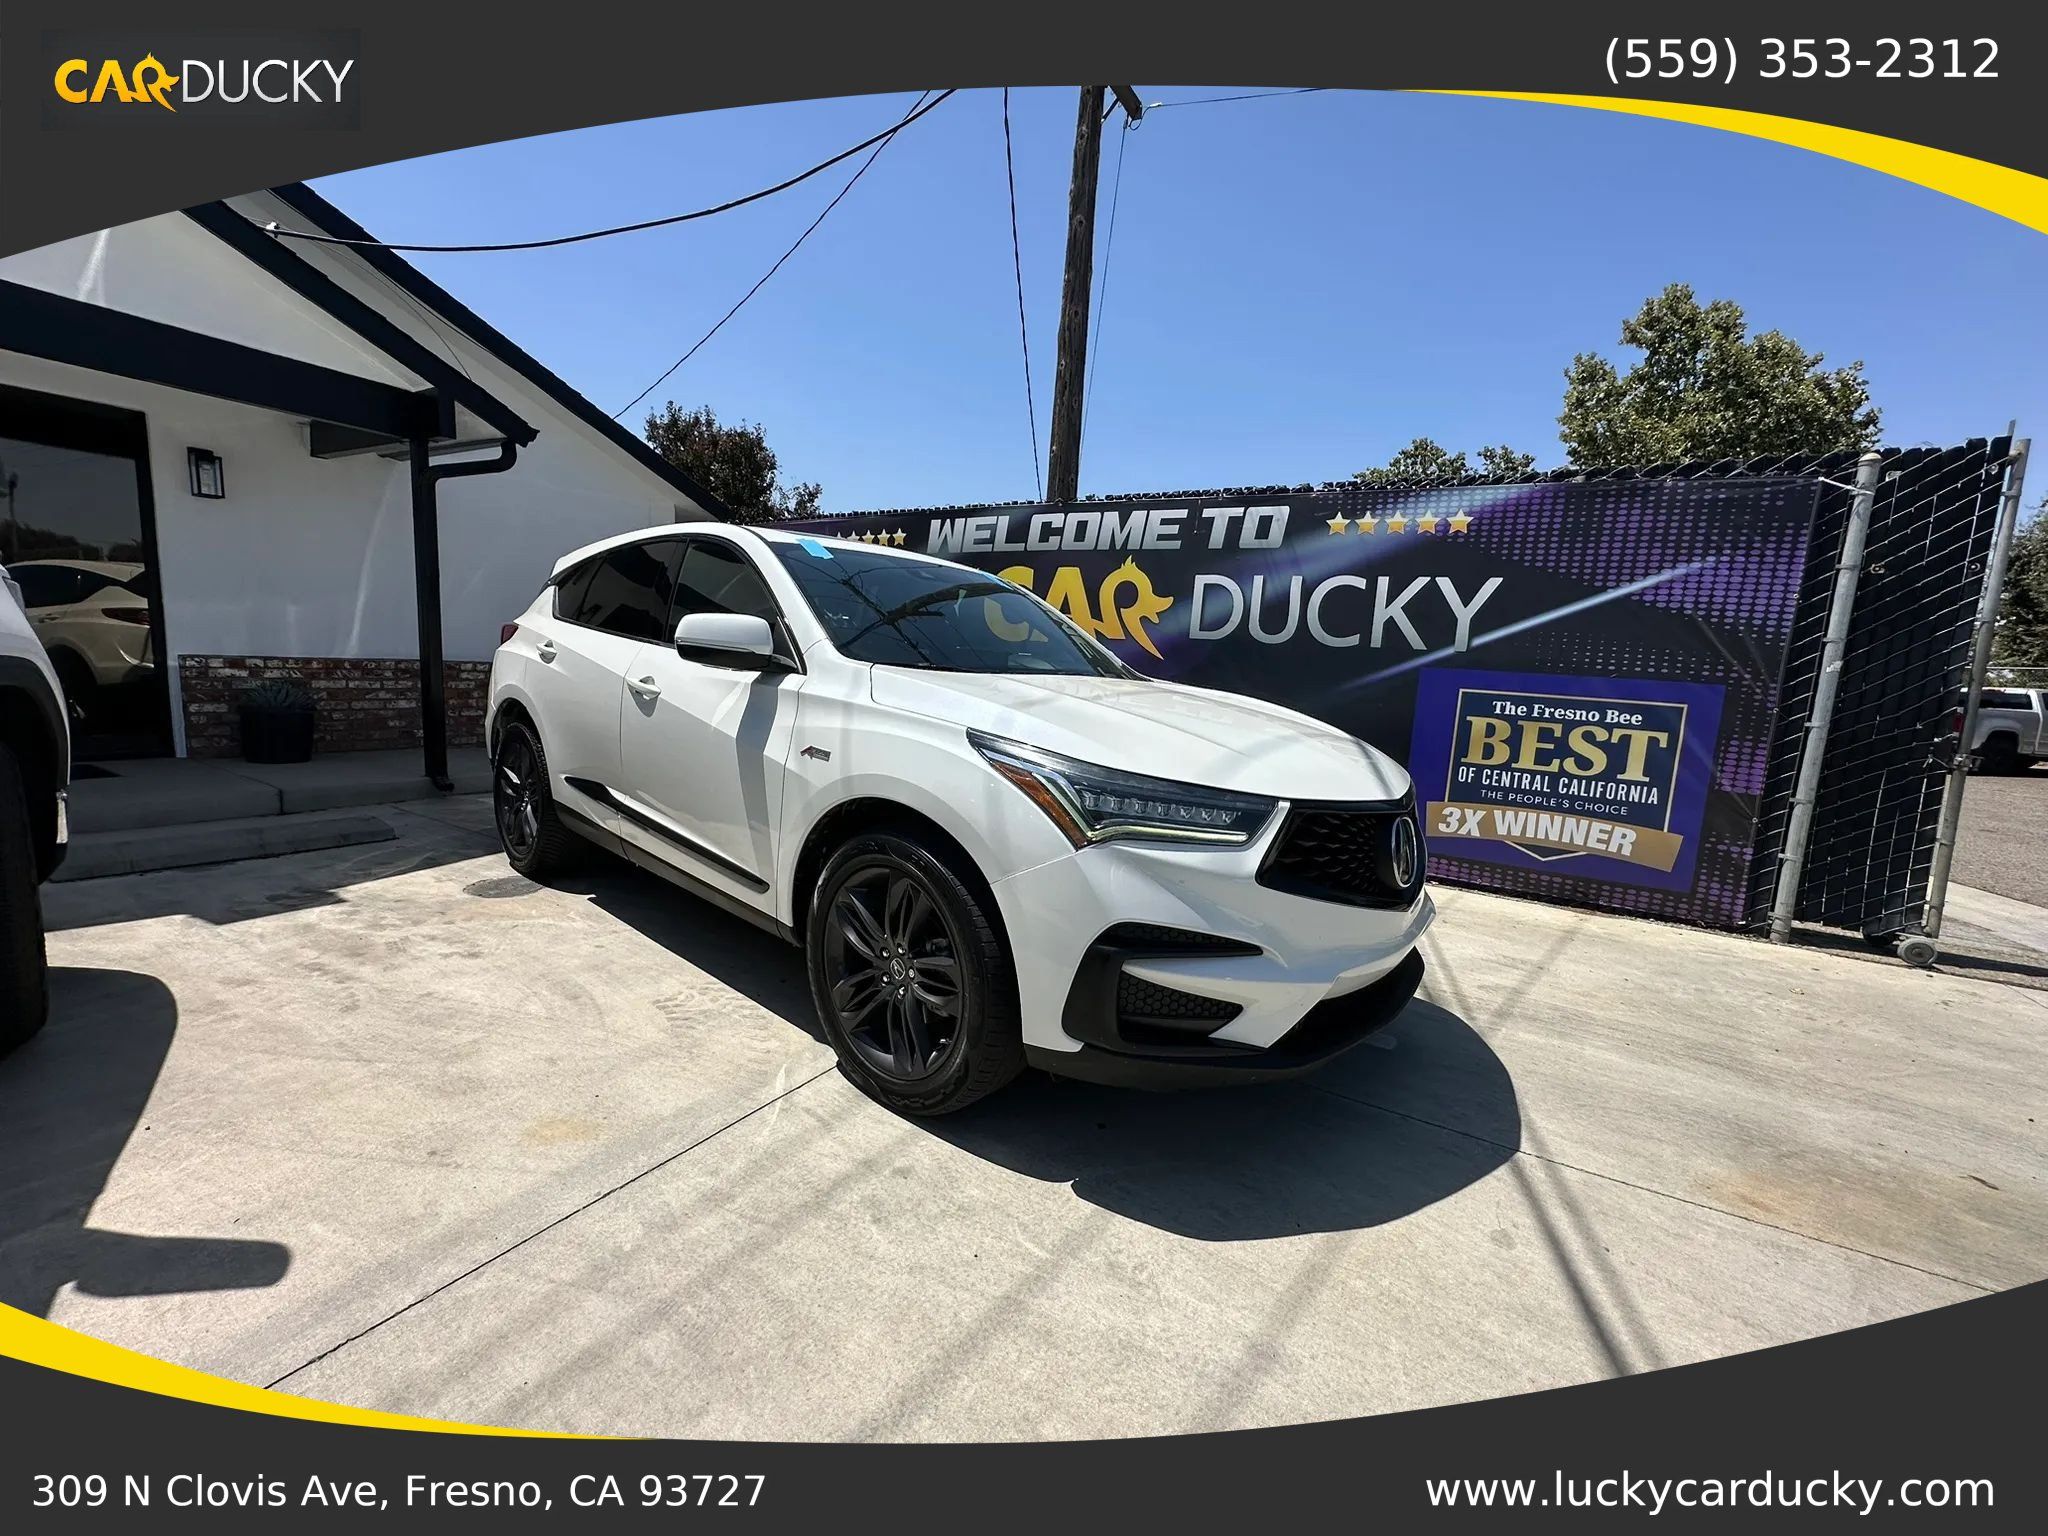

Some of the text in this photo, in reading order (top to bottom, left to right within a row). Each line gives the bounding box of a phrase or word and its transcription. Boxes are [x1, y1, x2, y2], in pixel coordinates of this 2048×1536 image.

[925, 505, 1290, 555] WELCOME TO
[1188, 573, 1504, 652] DUCKY
[1493, 700, 1643, 726] The Fresno Bee
[1460, 715, 1669, 782] BEST
[1457, 765, 1659, 805] OF CENTRAL CALIFORNIA
[1480, 789, 1629, 816] THE PEOPLE'S CHOICE
[1438, 806, 1637, 857] 3X WINNER
